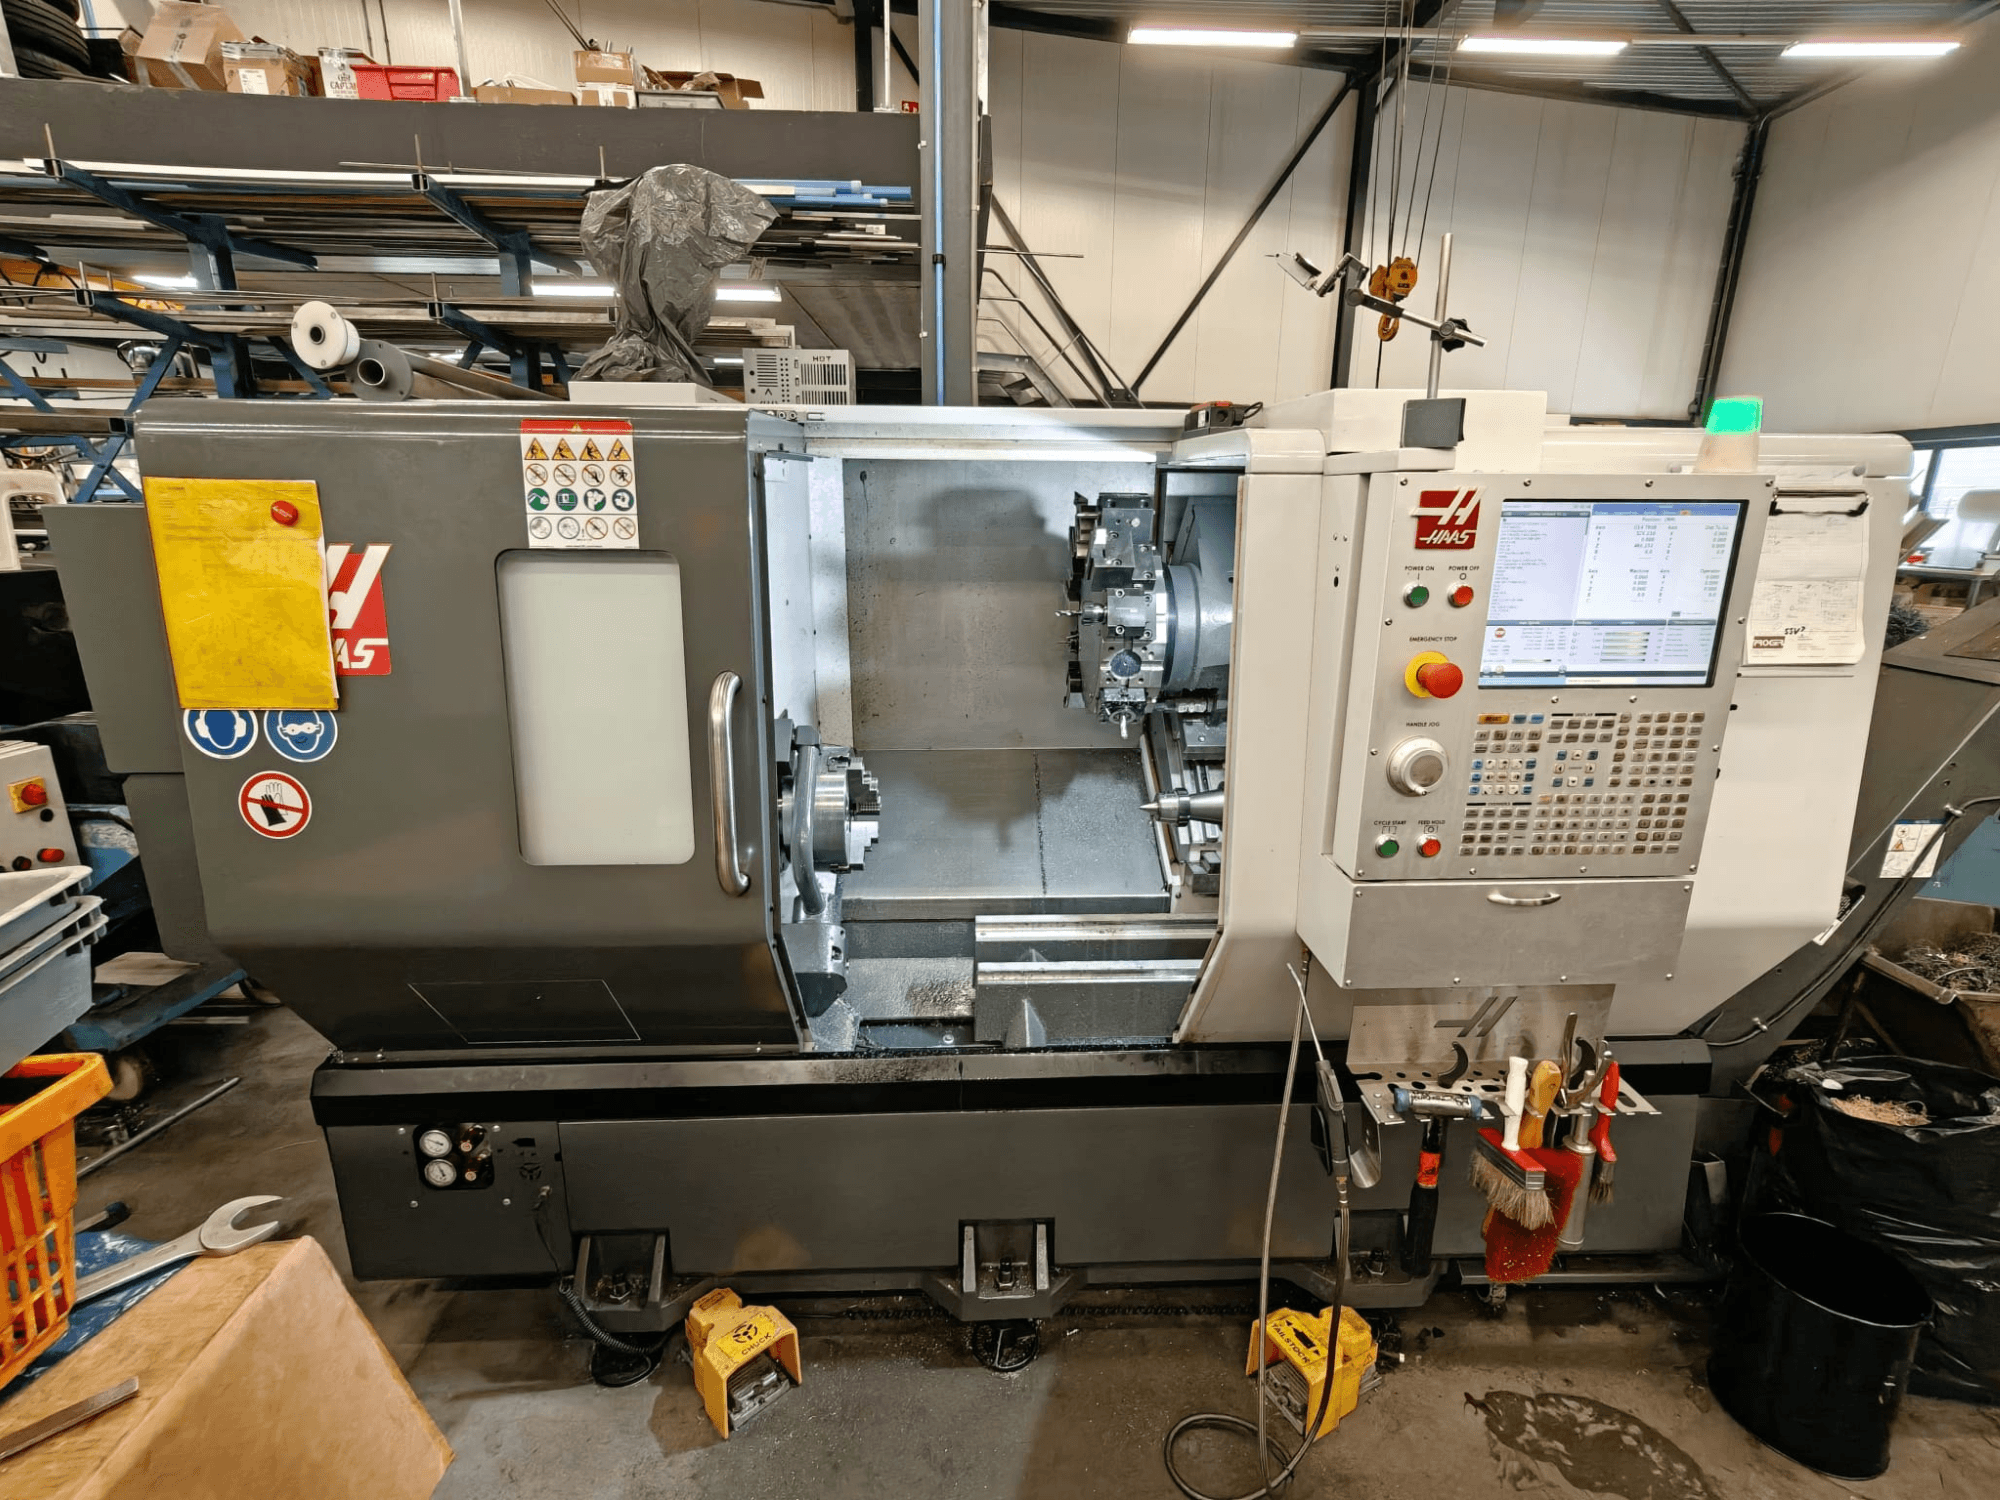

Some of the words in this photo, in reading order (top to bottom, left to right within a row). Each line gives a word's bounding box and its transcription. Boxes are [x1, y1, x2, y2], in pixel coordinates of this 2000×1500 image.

[1418, 529, 1477, 545] HAAS
[741, 1332, 772, 1355] CHUCK
[1271, 1322, 1311, 1363] TAILSTOCK
